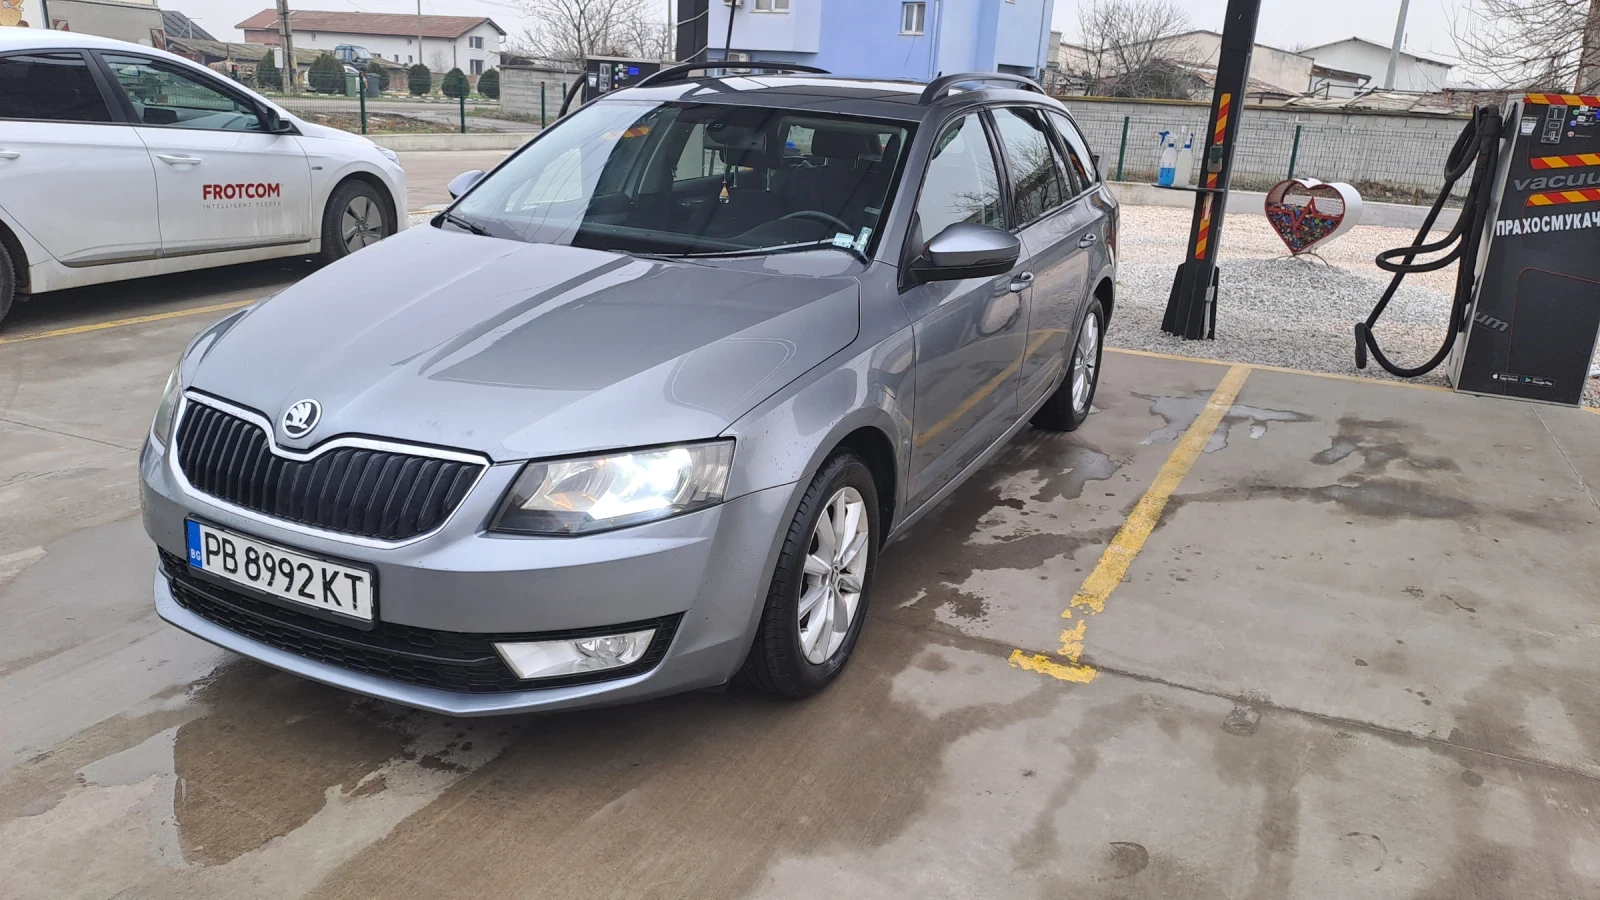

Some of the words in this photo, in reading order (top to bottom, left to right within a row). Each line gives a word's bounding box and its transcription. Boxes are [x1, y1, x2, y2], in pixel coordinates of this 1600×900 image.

[203, 183, 280, 200] FROTCOM
[203, 202, 252, 210] INTELLIGENT
[1496, 211, 1600, 236] ПРАХОСМУКАЧ
[190, 548, 201, 561] BG
[204, 531, 238, 575] PB
[245, 546, 315, 600] 8992
[321, 567, 364, 611] KT
